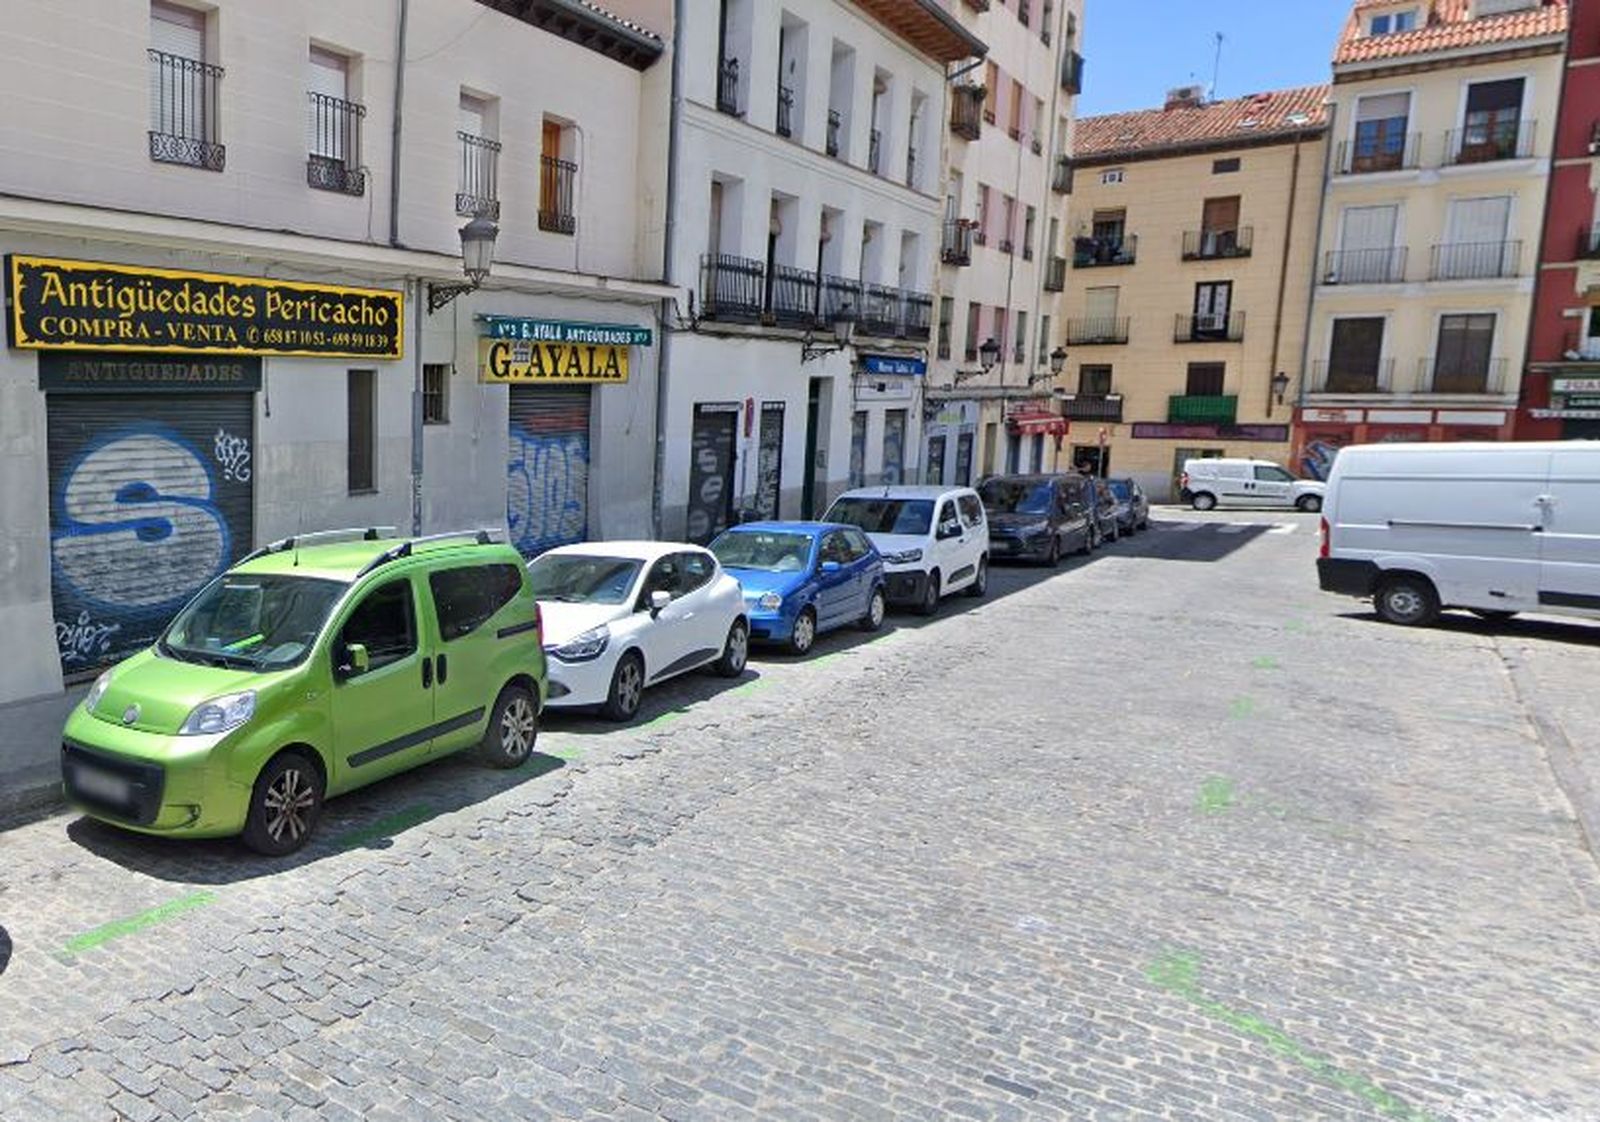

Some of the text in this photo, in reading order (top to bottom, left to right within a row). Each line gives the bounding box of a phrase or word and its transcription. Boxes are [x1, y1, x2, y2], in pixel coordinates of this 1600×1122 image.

[40, 271, 389, 327] Antigüedades Pericacho
[40, 316, 150, 339] COMPRA
[167, 321, 238, 342] VENTA
